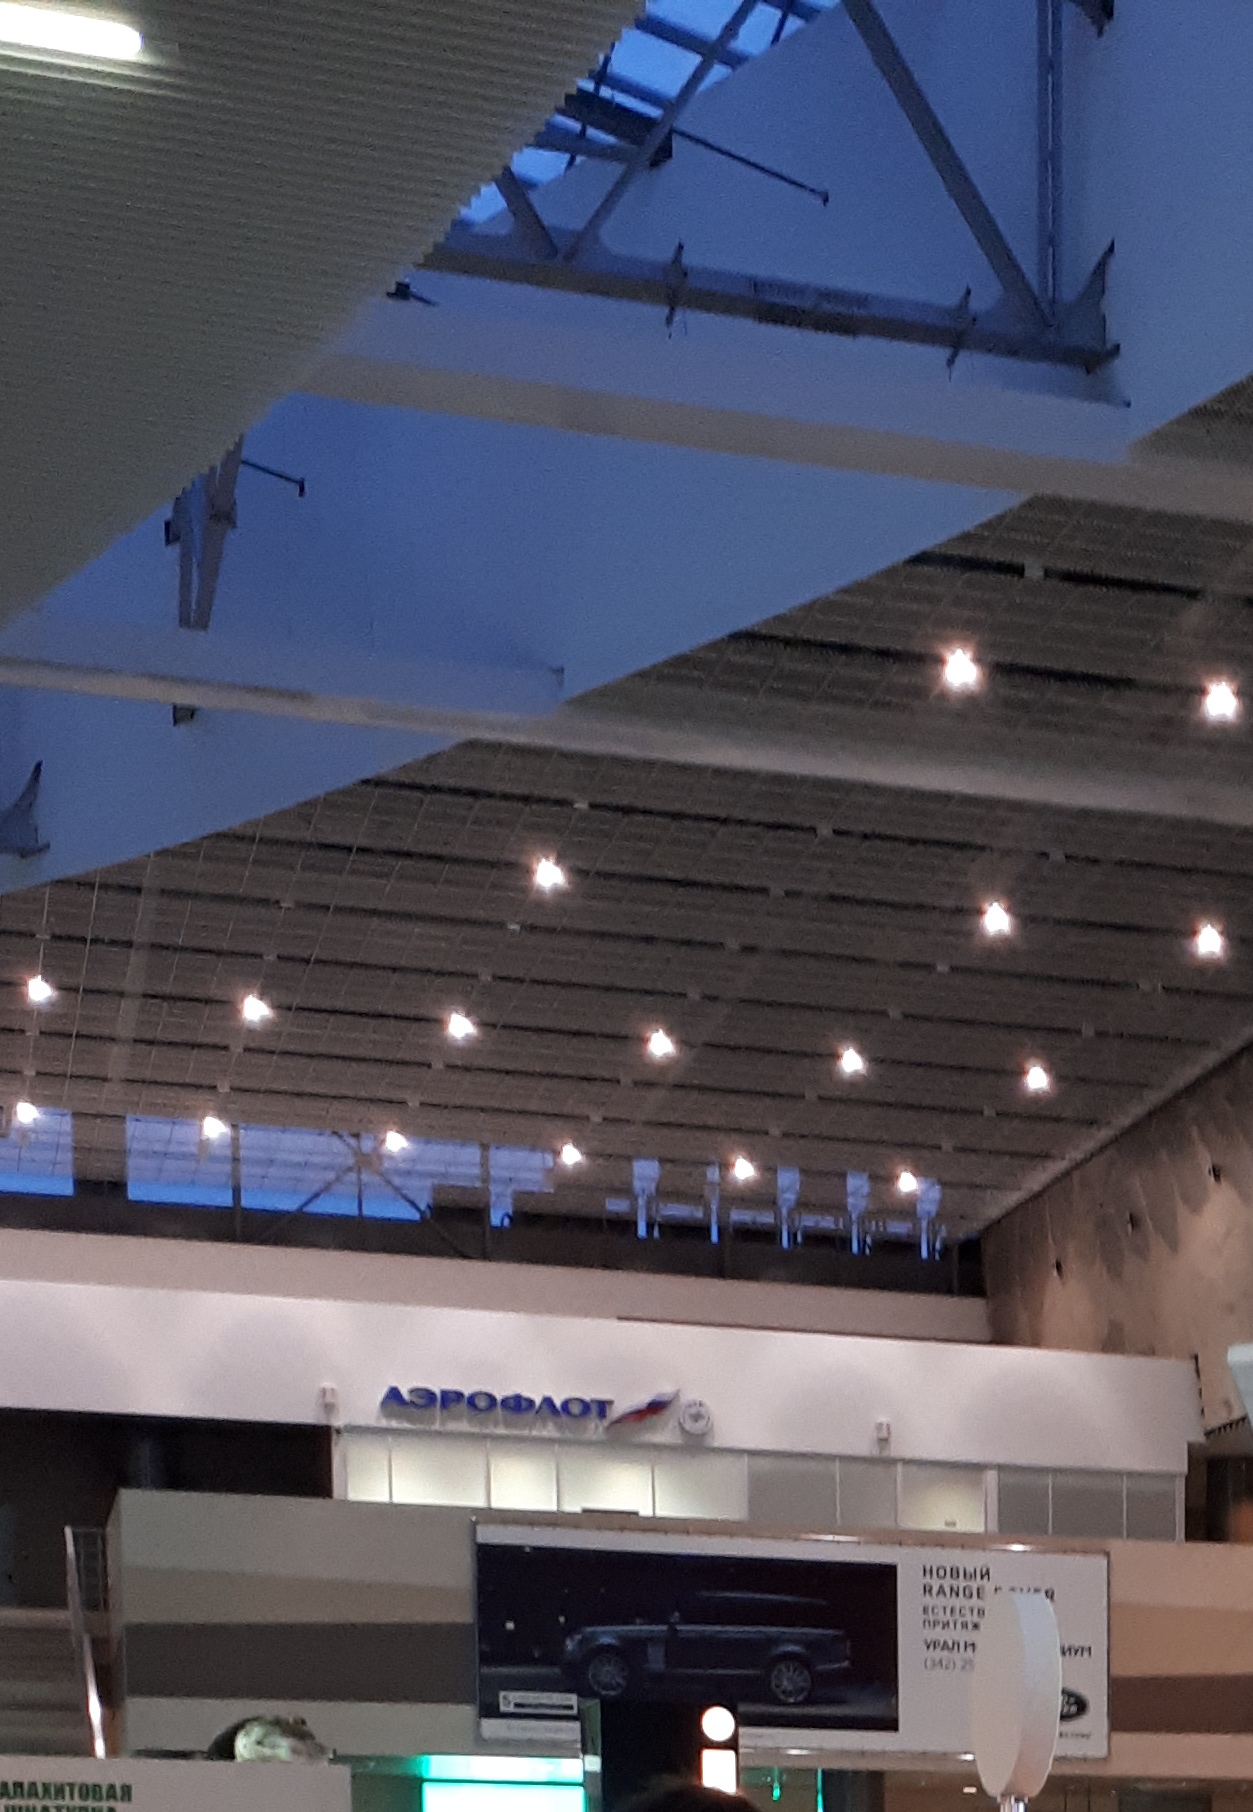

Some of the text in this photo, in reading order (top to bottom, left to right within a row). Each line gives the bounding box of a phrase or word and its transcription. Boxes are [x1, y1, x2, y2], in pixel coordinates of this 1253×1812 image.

[380, 1386, 615, 1420] АЭРОФЛОТ
[922, 1564, 991, 1582] НОВЫЙ
[922, 1583, 985, 1600] RANGE
[922, 1604, 986, 1619] ЕСТЕСТВ
[922, 1618, 981, 1632] ПРИТЯЖ
[1061, 1643, 1093, 1659] ИУМ
